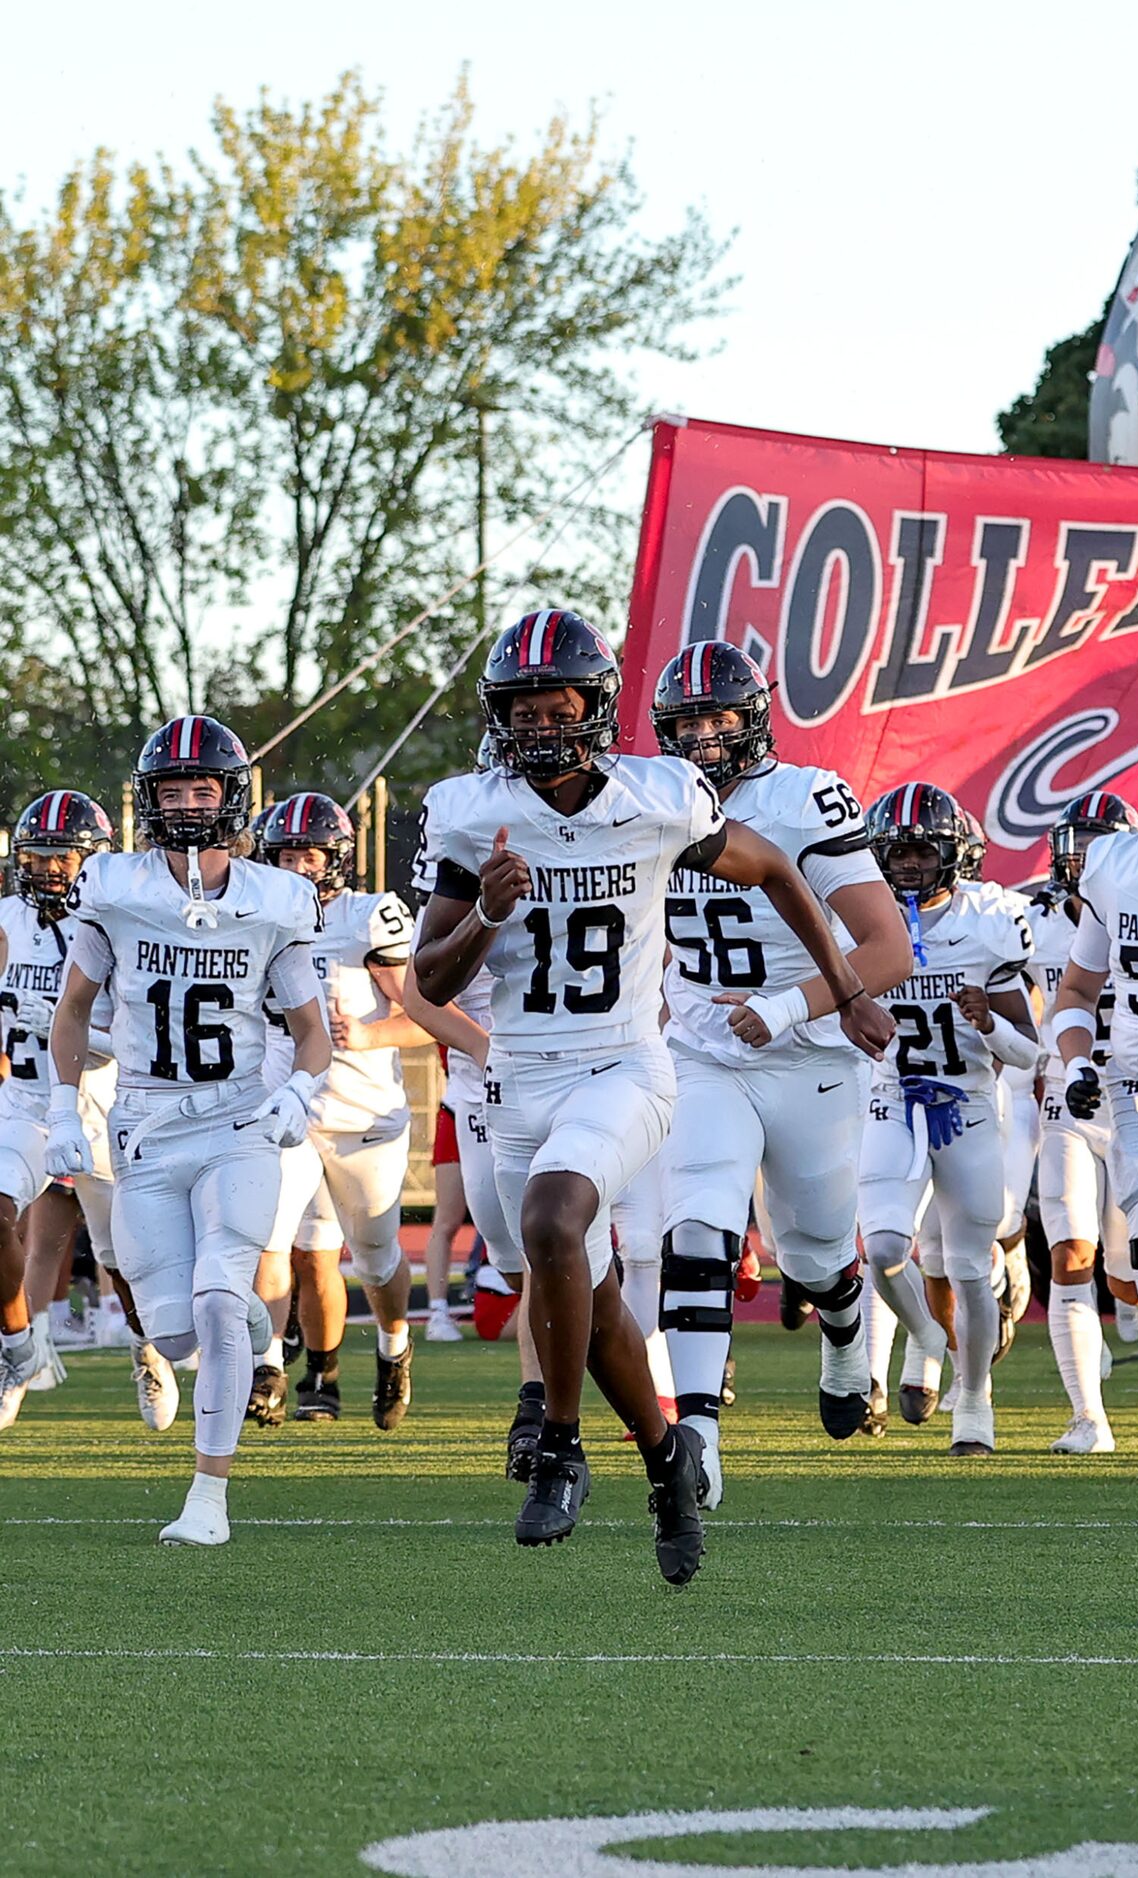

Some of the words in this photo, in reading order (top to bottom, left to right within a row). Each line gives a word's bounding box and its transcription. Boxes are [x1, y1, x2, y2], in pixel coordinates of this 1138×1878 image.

[519, 862, 637, 902] ANTHERS
[136, 939, 250, 980] PANTHERS
[523, 904, 626, 1015] 19
[664, 897, 768, 988] 56
[146, 978, 236, 1084] 16
[889, 1002, 968, 1078] 21
